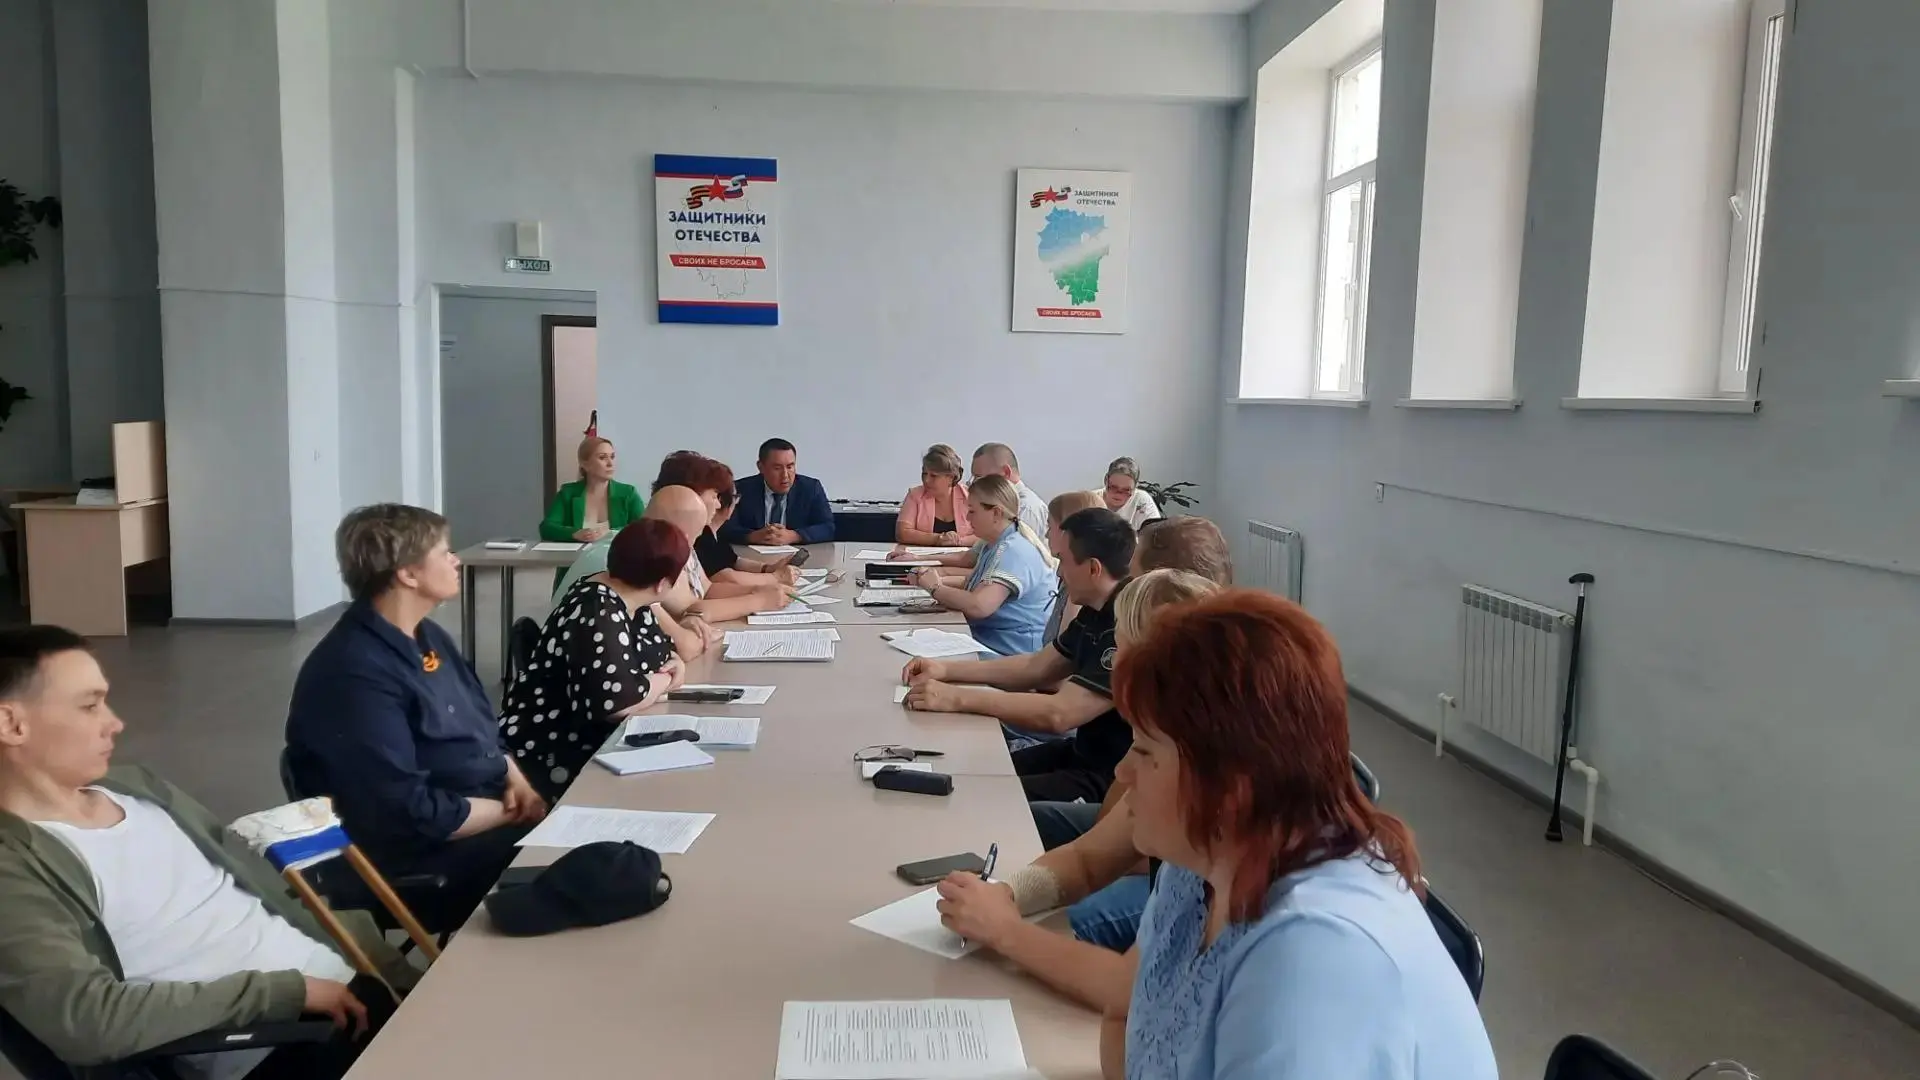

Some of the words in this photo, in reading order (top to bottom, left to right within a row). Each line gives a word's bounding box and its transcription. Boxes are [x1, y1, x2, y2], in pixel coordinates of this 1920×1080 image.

[669, 211, 766, 225] ЗАЩИТНИКИ
[675, 230, 760, 243] ОТЕЧЕСТВА
[678, 257, 706, 265] СВОИХ
[719, 258, 757, 266] БРОСАЕМ
